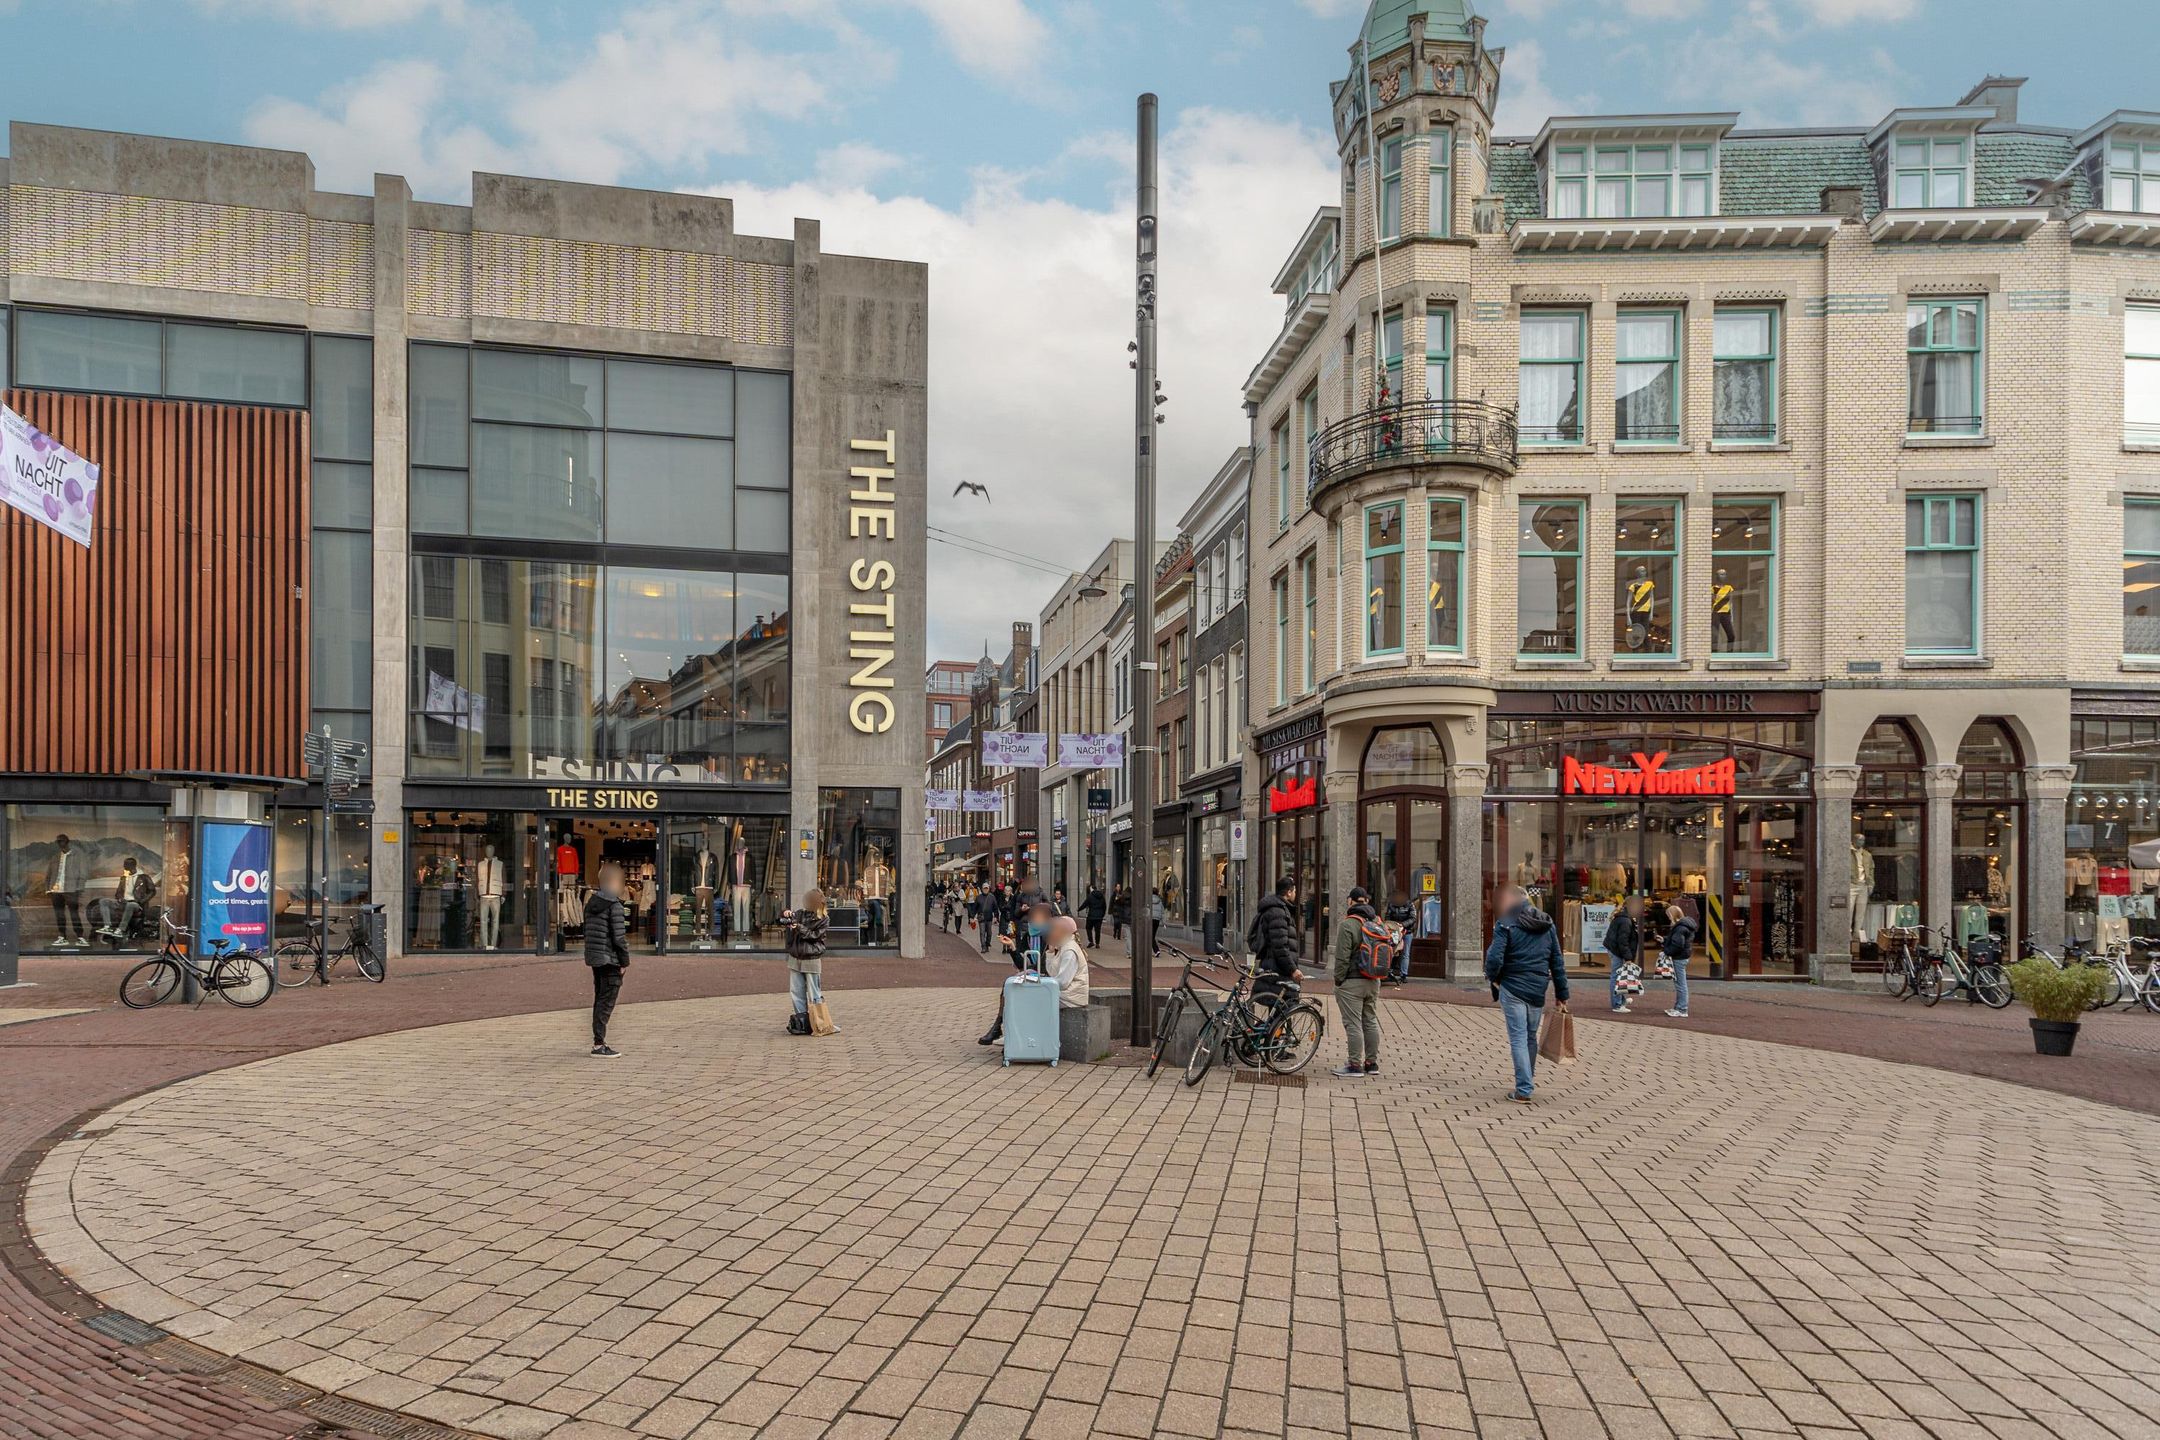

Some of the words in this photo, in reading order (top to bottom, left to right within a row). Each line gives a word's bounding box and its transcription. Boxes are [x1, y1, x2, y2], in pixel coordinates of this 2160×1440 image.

[45, 451, 68, 477] UIT
[15, 454, 63, 498] NACHT
[850, 429, 895, 540] THE
[849, 558, 895, 734] STING
[1553, 692, 1755, 712] MUSISKWARTIER
[1076, 746, 1106, 755] NACHT
[1093, 738, 1106, 747] UIT
[546, 788, 588, 809] THE
[594, 789, 659, 809] STING
[209, 898, 229, 906] good
[231, 898, 250, 906] times,
